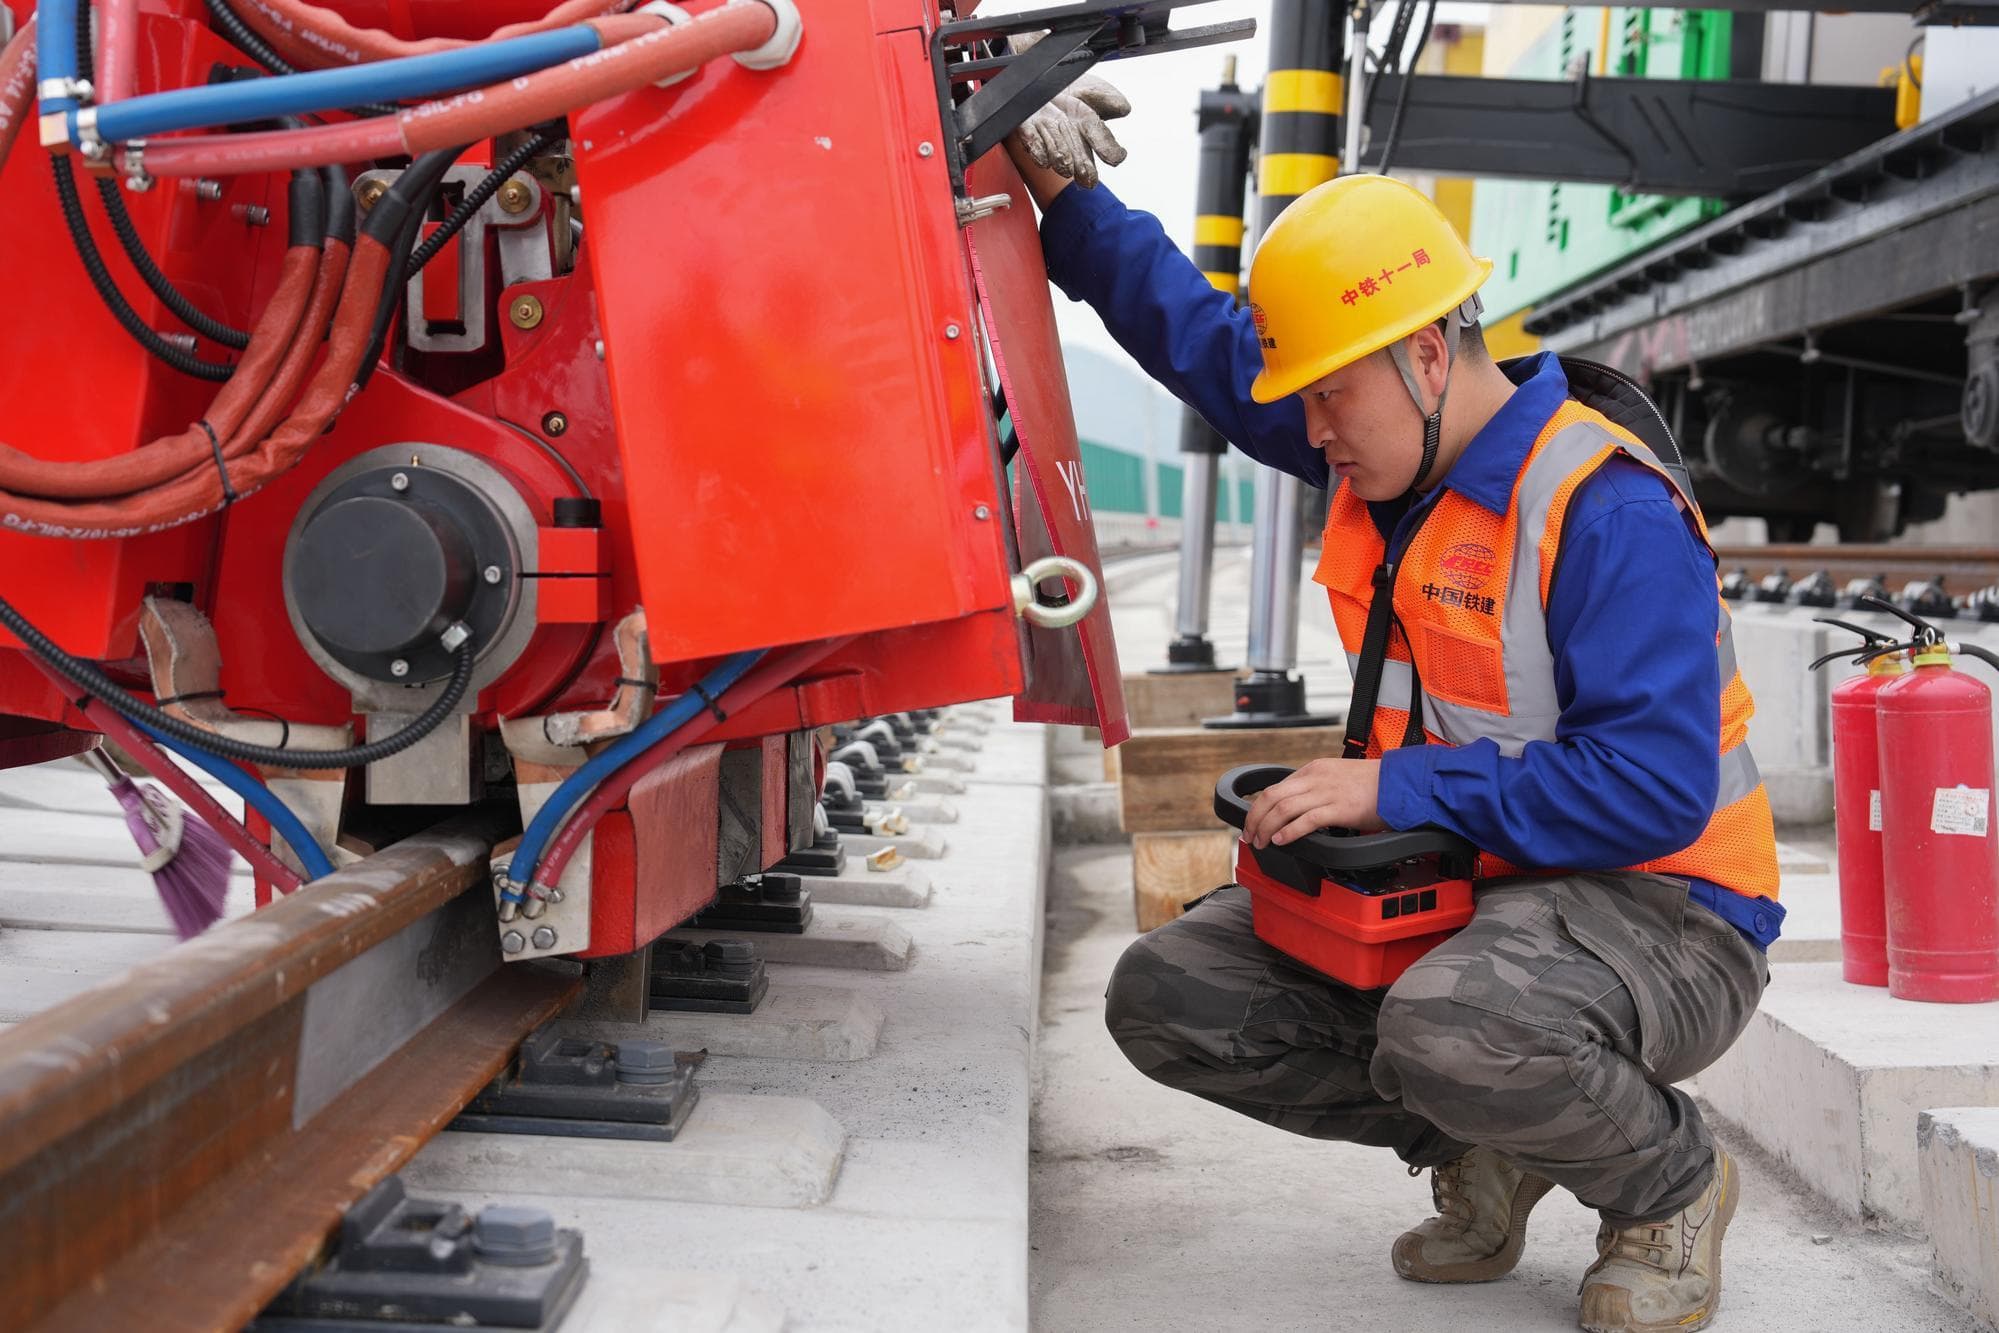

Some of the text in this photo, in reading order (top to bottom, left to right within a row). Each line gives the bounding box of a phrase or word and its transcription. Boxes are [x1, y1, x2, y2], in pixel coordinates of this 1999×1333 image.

[1341, 248, 1431, 307] 中铁十一局
[1421, 582, 1496, 616] 中国铁建
